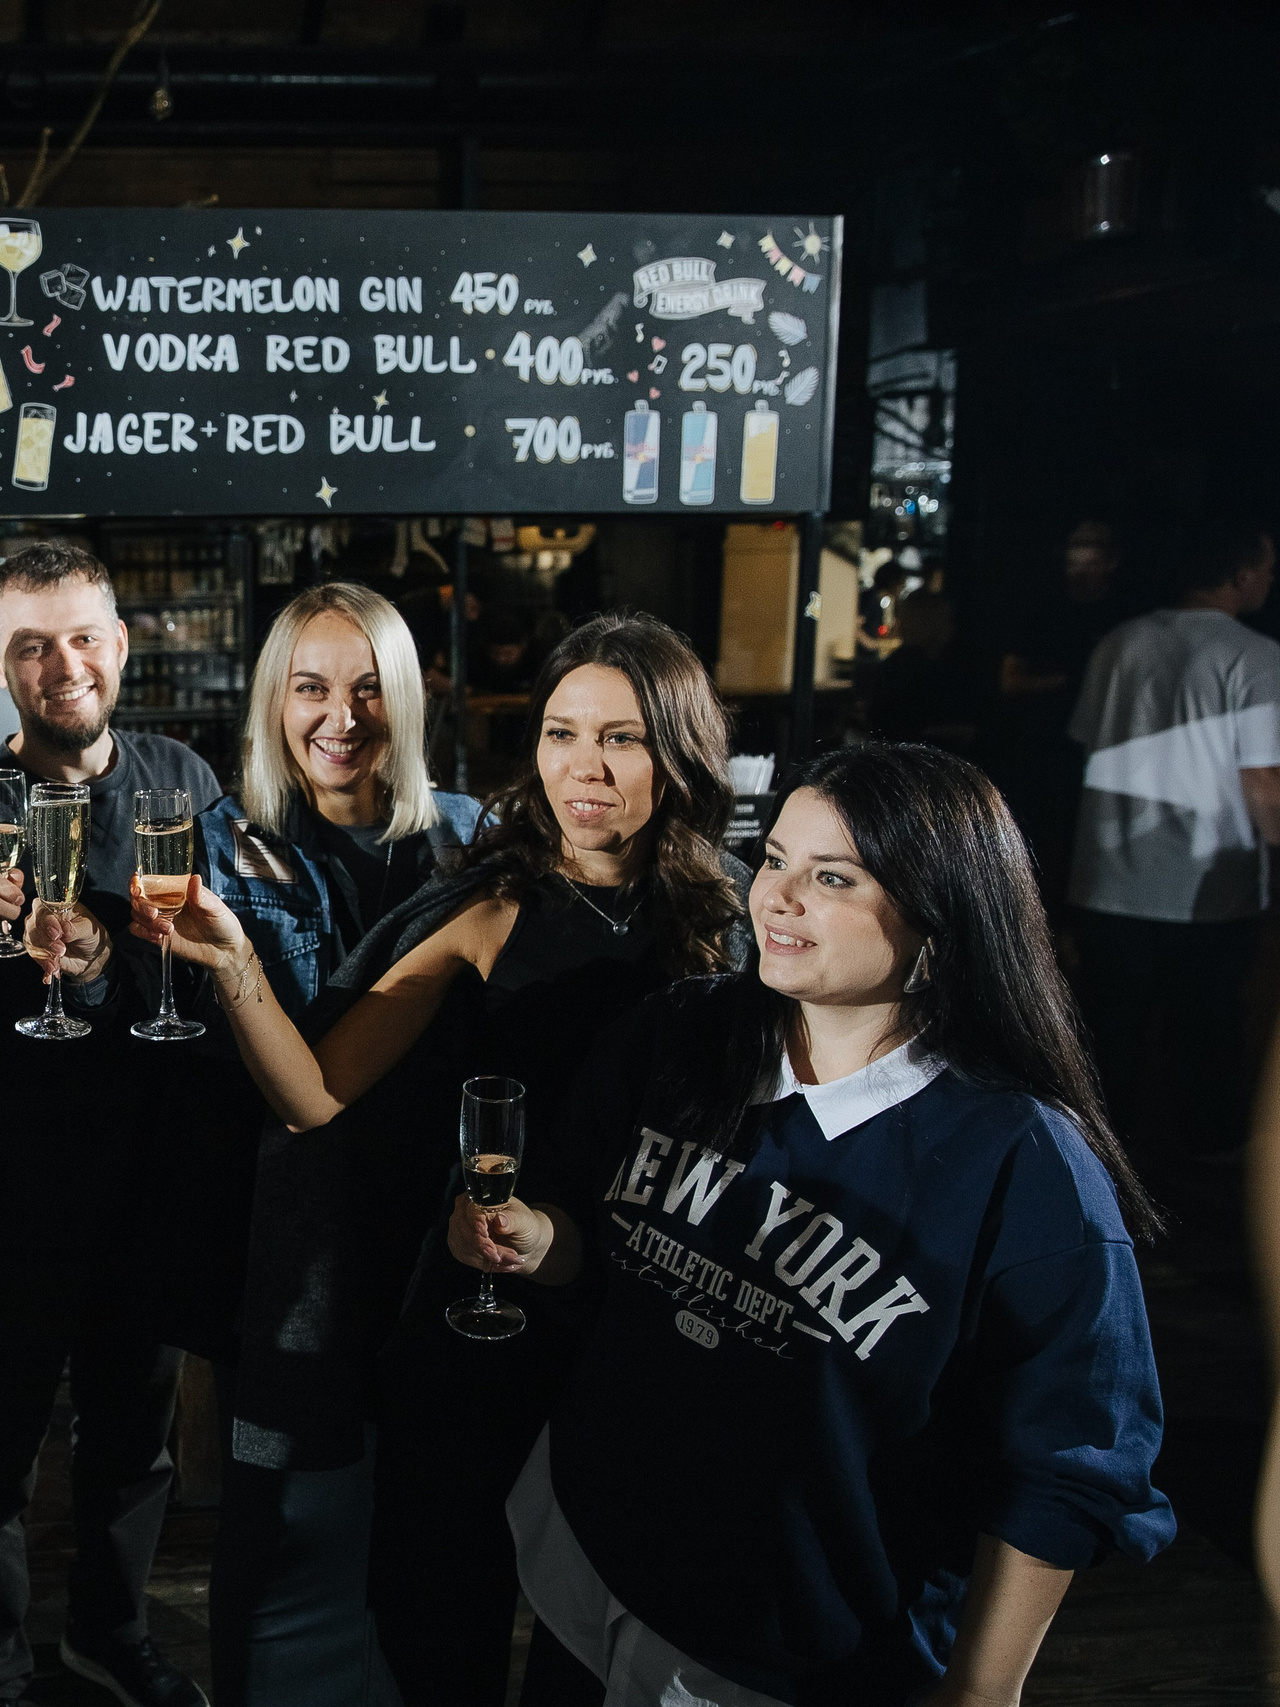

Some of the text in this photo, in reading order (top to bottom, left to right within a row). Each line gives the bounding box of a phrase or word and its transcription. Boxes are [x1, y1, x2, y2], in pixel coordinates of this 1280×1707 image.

[91, 274, 340, 314] WATERMELON
[359, 276, 422, 314] GIN
[449, 271, 519, 315] 450
[672, 260, 709, 282] BULL
[102, 333, 240, 373] VODKA
[266, 334, 351, 373] RED
[373, 333, 478, 375] BULL
[502, 330, 584, 385] 400
[678, 342, 757, 394] 250
[329, 414, 437, 455] BULL
[504, 415, 581, 464] 700
[625, 1220, 795, 1334] ATHLETIC DEPT
[743, 1180, 931, 1361] YORK
[610, 1251, 794, 1360] established
[680, 1313, 716, 1346] 1979
